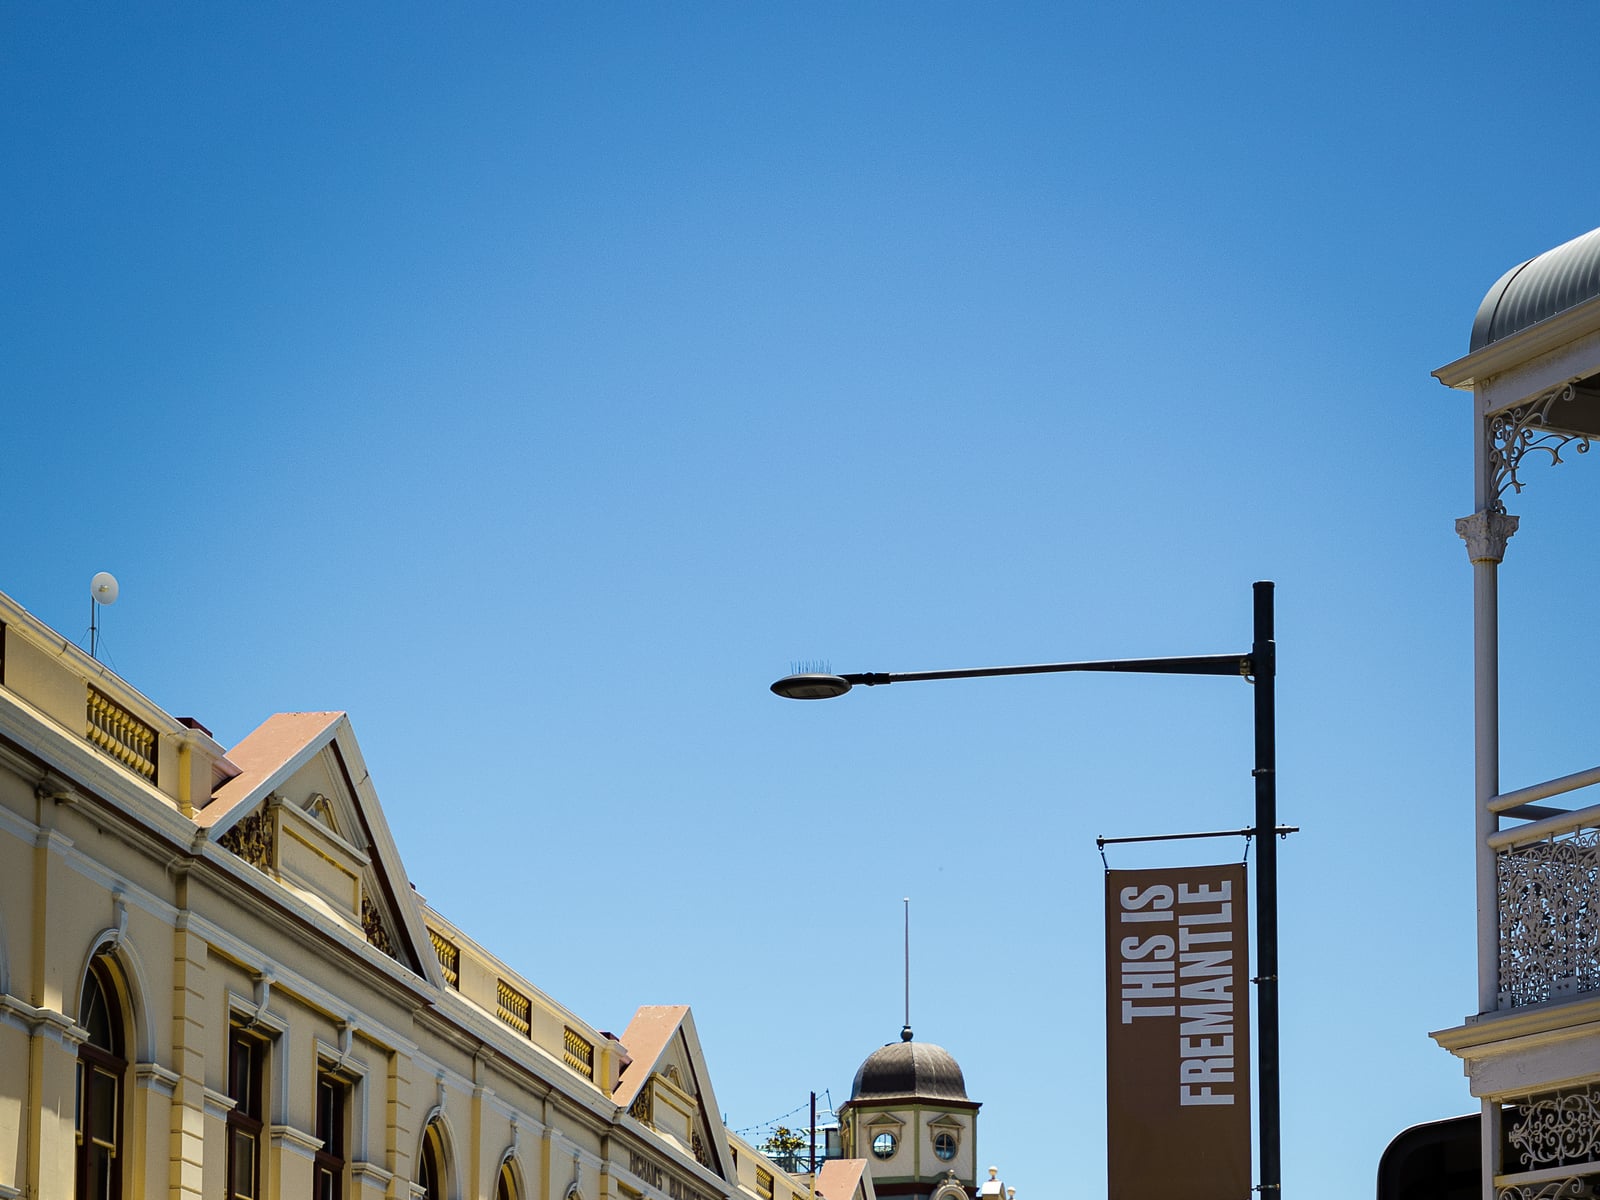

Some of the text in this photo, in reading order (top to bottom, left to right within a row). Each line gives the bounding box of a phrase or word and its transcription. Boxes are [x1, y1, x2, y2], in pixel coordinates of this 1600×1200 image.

[1120, 884, 1175, 1025] THIS IS
[1178, 880, 1235, 1106] FREMANTLE
